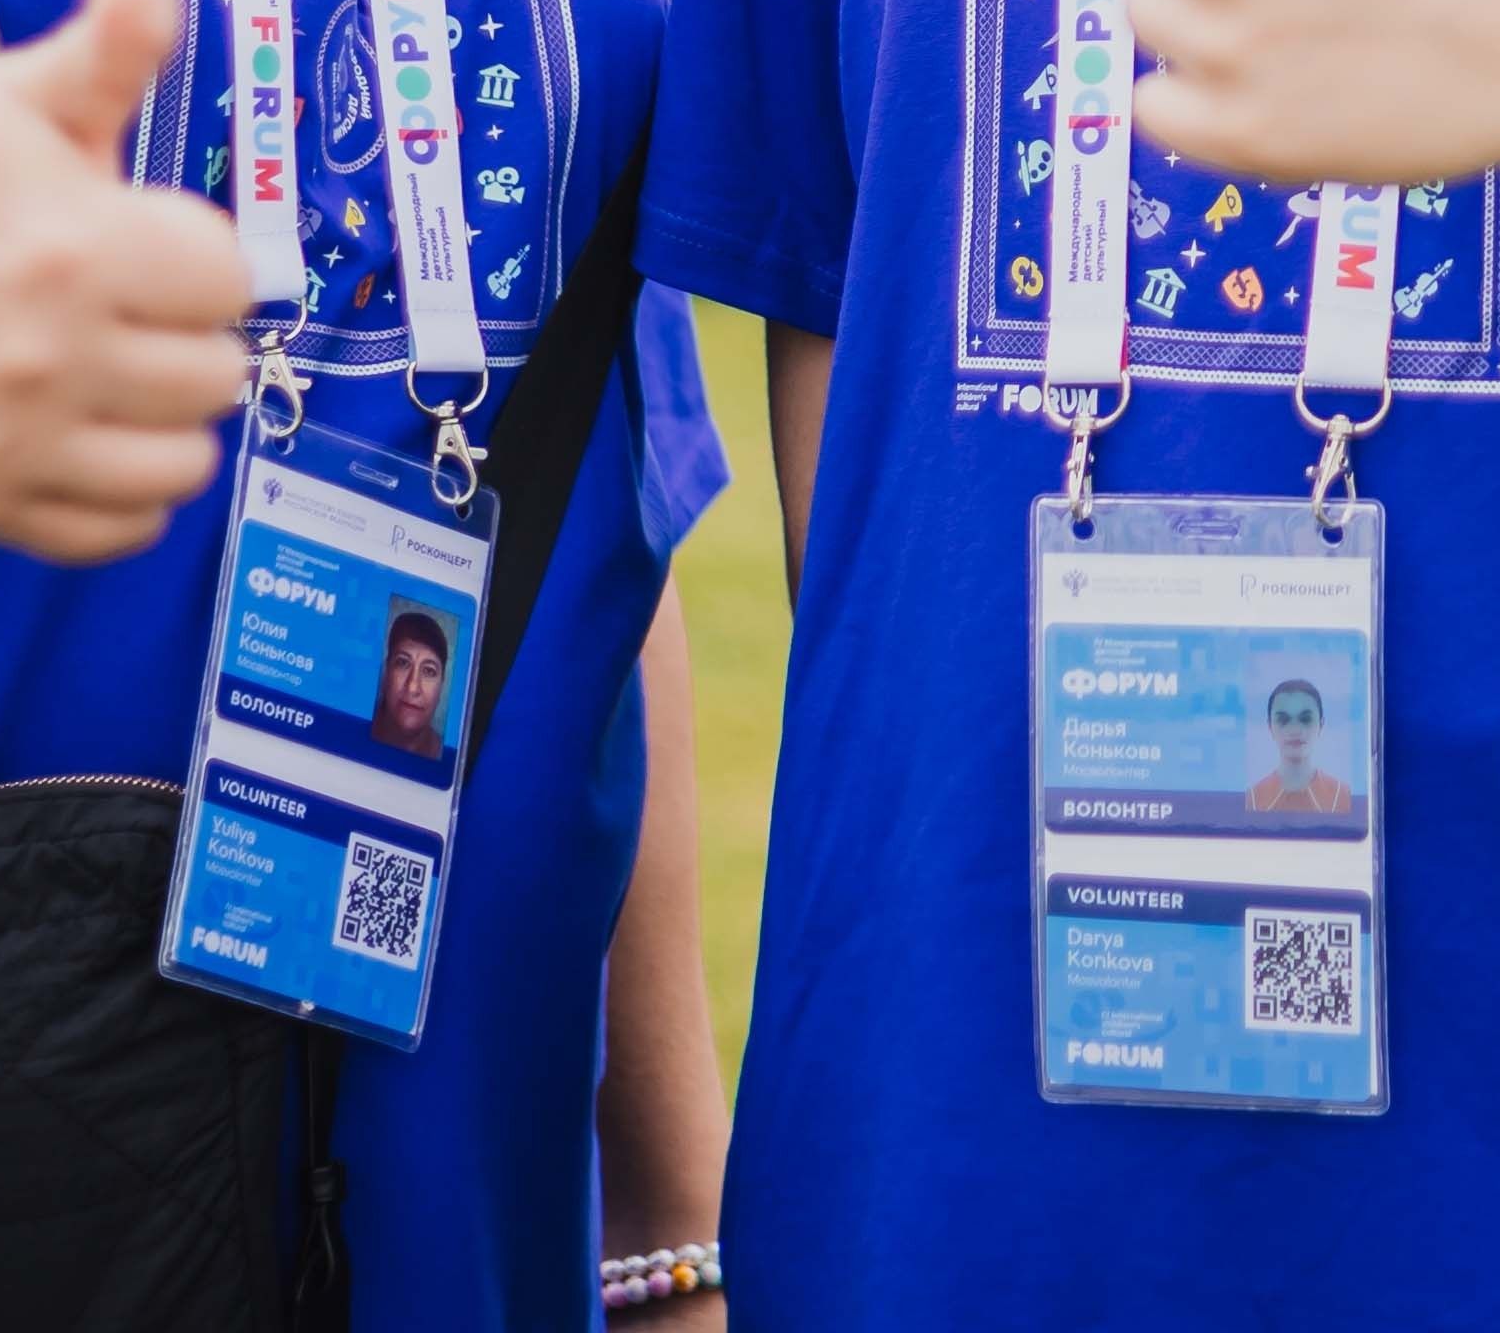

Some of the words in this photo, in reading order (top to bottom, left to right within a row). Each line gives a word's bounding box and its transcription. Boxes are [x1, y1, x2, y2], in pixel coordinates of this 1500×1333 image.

[251, 16, 283, 201] FORUM
[407, 172, 430, 281] Международный
[1068, 163, 1082, 282] Международный
[428, 228, 443, 281] детский
[439, 206, 454, 281] культурный
[1083, 224, 1092, 282] детский
[1097, 199, 1106, 282] культурный
[407, 538, 472, 570] РОСКОНЦЕРТ
[248, 566, 336, 615] ФОРУМ
[1262, 583, 1351, 597] РОСКОНЦЕРТ
[242, 611, 288, 641] Юлия
[239, 633, 314, 672] Конькова
[1062, 669, 1178, 701] ФОРУМ
[231, 691, 313, 729] ВОЛОНТЕР
[1063, 717, 1126, 739] Дарья
[1063, 741, 1160, 761] Конькова
[219, 777, 307, 819] VOLUNTEER
[1063, 801, 1172, 819] ВОЛОНТЕР
[213, 816, 256, 846] Yuliya
[208, 839, 274, 874] Konkova
[1068, 888, 1184, 909] VOLUNTEER
[192, 926, 268, 969] FORUM
[1068, 927, 1124, 949] Darya
[1068, 949, 1153, 972] Konkova
[1068, 1040, 1163, 1069] FORUM
